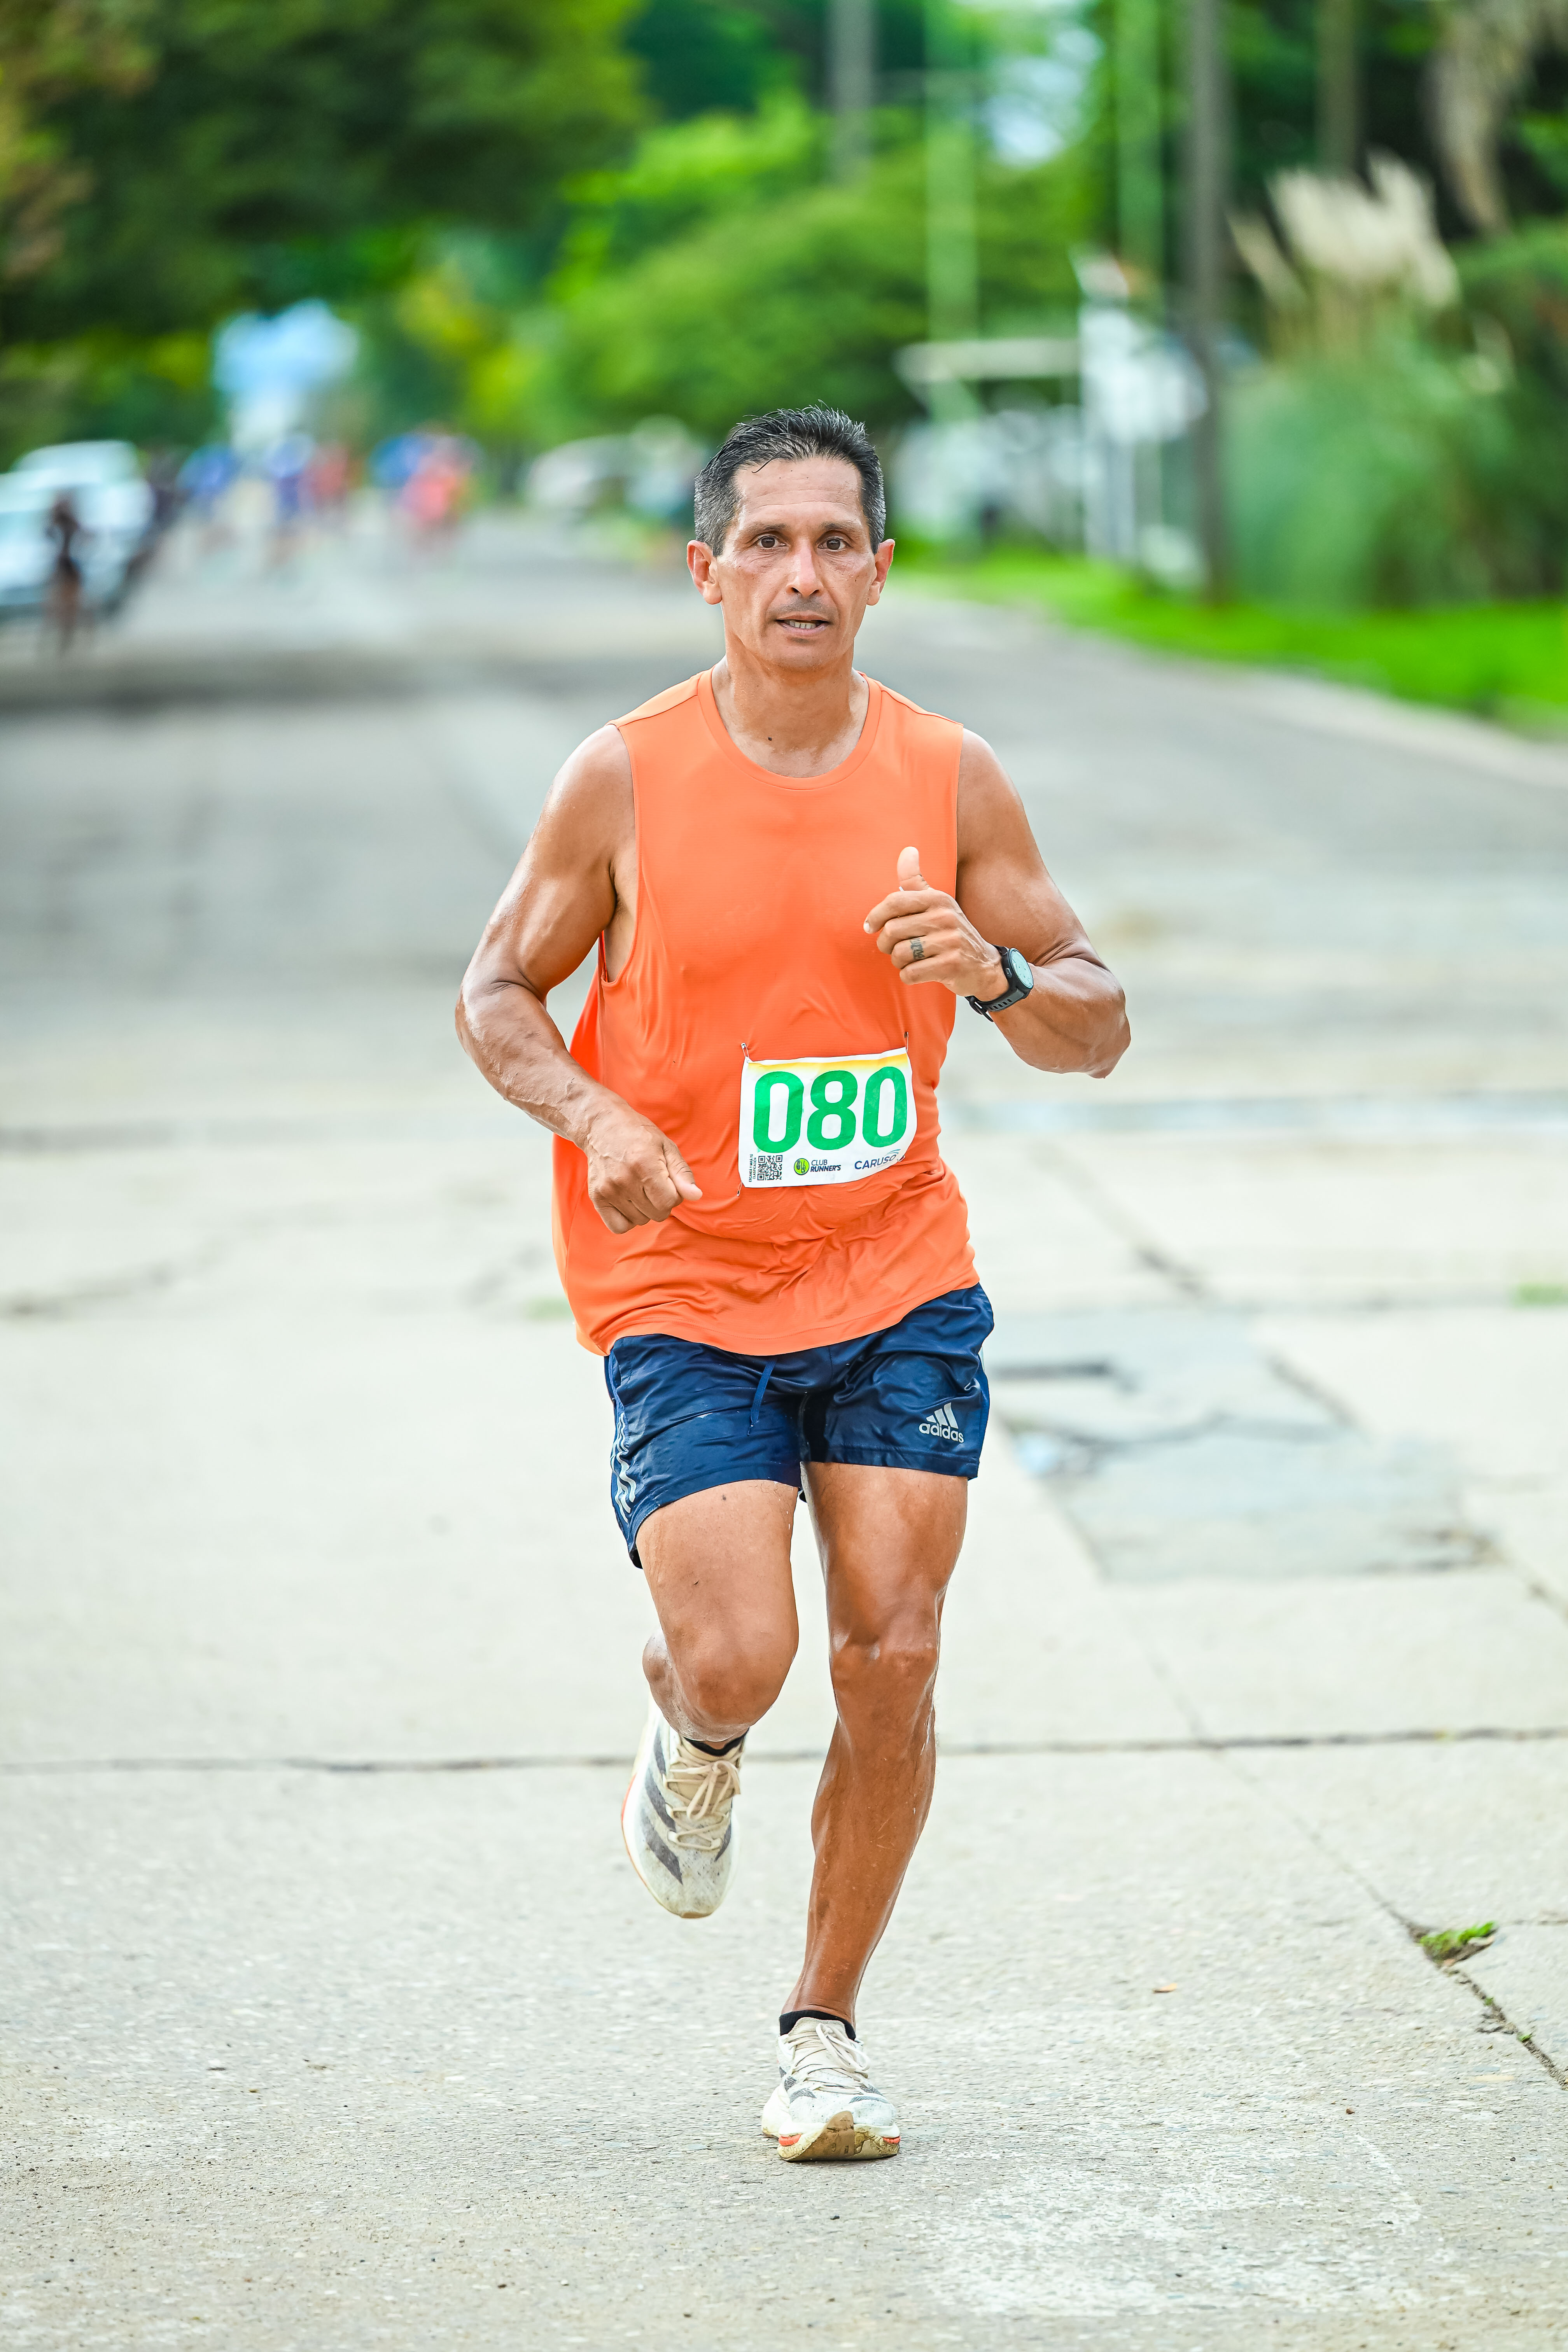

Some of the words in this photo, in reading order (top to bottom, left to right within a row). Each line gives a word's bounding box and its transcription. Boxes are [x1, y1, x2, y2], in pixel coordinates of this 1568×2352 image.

[753, 1066, 907, 1153] 080
[854, 1154, 897, 1170] CARUSO
[919, 1423, 964, 1443] adidas
